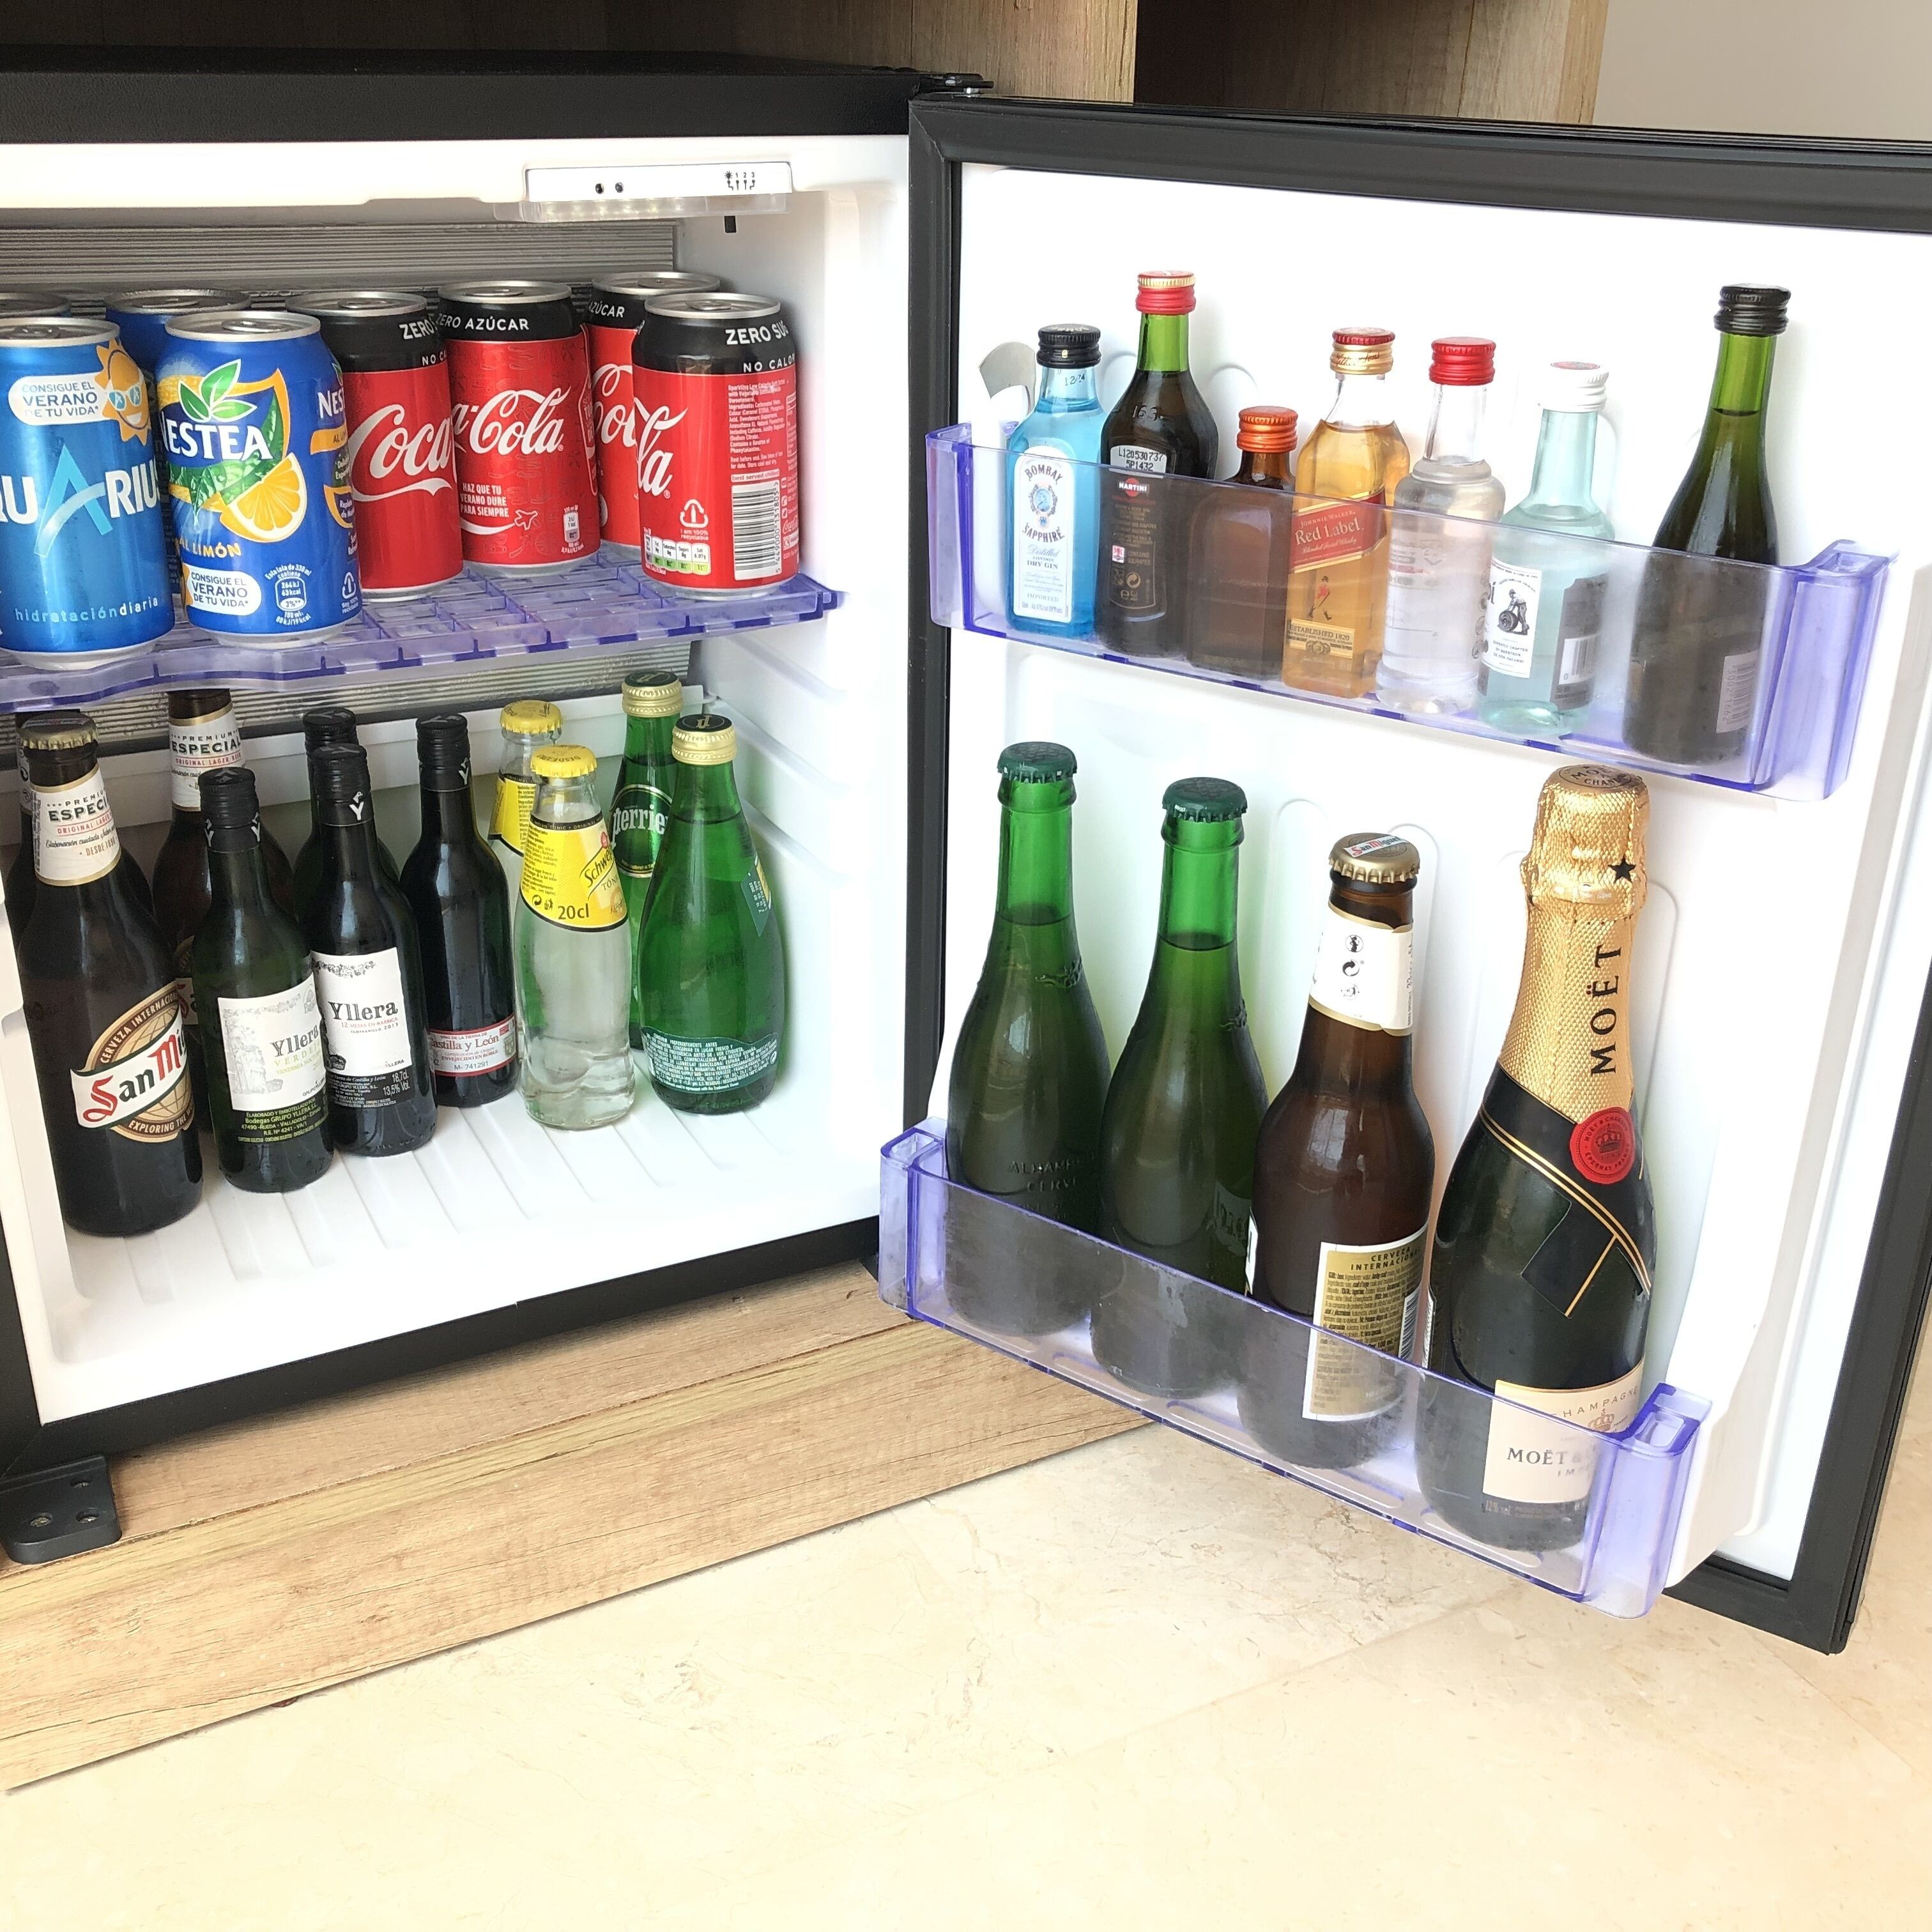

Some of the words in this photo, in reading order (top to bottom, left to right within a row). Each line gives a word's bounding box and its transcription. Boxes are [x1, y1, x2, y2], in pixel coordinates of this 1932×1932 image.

[399, 319, 436, 340] ZERO
[465, 316, 530, 332] AZÚCAR
[725, 326, 772, 346] ZERO
[422, 353, 436, 366] NO
[743, 361, 763, 373] NO
[769, 352, 795, 371] CALOR
[22, 382, 79, 394] CONSIGUE
[81, 381, 95, 391] EL
[22, 391, 98, 408] VERANO
[318, 387, 346, 418] NES
[45, 408, 63, 417] TU
[746, 472, 764, 480] served
[1024, 463, 1064, 486] BOMBAY
[463, 482, 475, 494] HAZ
[477, 484, 491, 495] QUE
[491, 485, 502, 495] TU
[1119, 481, 1148, 492] MARTINI
[461, 493, 486, 506] VERANO
[487, 496, 507, 507] DURE
[461, 505, 477, 516] PARA
[477, 506, 510, 518] SIEMPRE
[1022, 523, 1066, 543] SAPPHIRE
[1294, 525, 1322, 546] Red
[192, 542, 241, 558] LIMÓN
[1027, 560, 1043, 569] DRY
[1044, 562, 1059, 570] GIN
[191, 571, 232, 585] CONSIGUE
[234, 578, 247, 586] EL
[191, 581, 248, 598] VERANO
[194, 594, 204, 603] DE
[205, 596, 218, 606] TU
[1027, 593, 1059, 603] IMPORTED
[1289, 624, 1334, 638] ESTABLISHED
[1335, 632, 1351, 641] 1820
[182, 731, 233, 742] PREMIUM
[171, 736, 241, 755] ESPECIAL
[175, 758, 206, 766] ORIGINAL
[209, 756, 230, 765] LAGER
[65, 788, 104, 807] PREMIU
[48, 795, 108, 824] ESPECI
[57, 822, 94, 834] ORIGINAL
[86, 843, 105, 857] DESDE
[328, 1000, 399, 1022] Yllera
[1586, 944, 1622, 1075] MOËT
[100, 1023, 133, 1064] CERVEZA
[131, 991, 179, 1028] INTERNACIO
[269, 1024, 319, 1058] Yllera
[464, 1042, 472, 1052] y
[475, 1035, 500, 1048] León
[385, 1059, 405, 1069] YLLERA
[464, 1060, 489, 1071] 741291
[383, 1082, 401, 1097] 13,5%
[245, 1117, 270, 1125] Bodegas
[271, 1113, 292, 1123] GRUPO
[292, 1106, 311, 1118] YLLERA
[128, 1119, 175, 1133] EXPLORING
[176, 1116, 187, 1128] THE
[1371, 1246, 1411, 1262] CERVEZA
[1554, 1385, 1638, 1418] HAMPAGNE
[1506, 1446, 1568, 1466] MOËT
